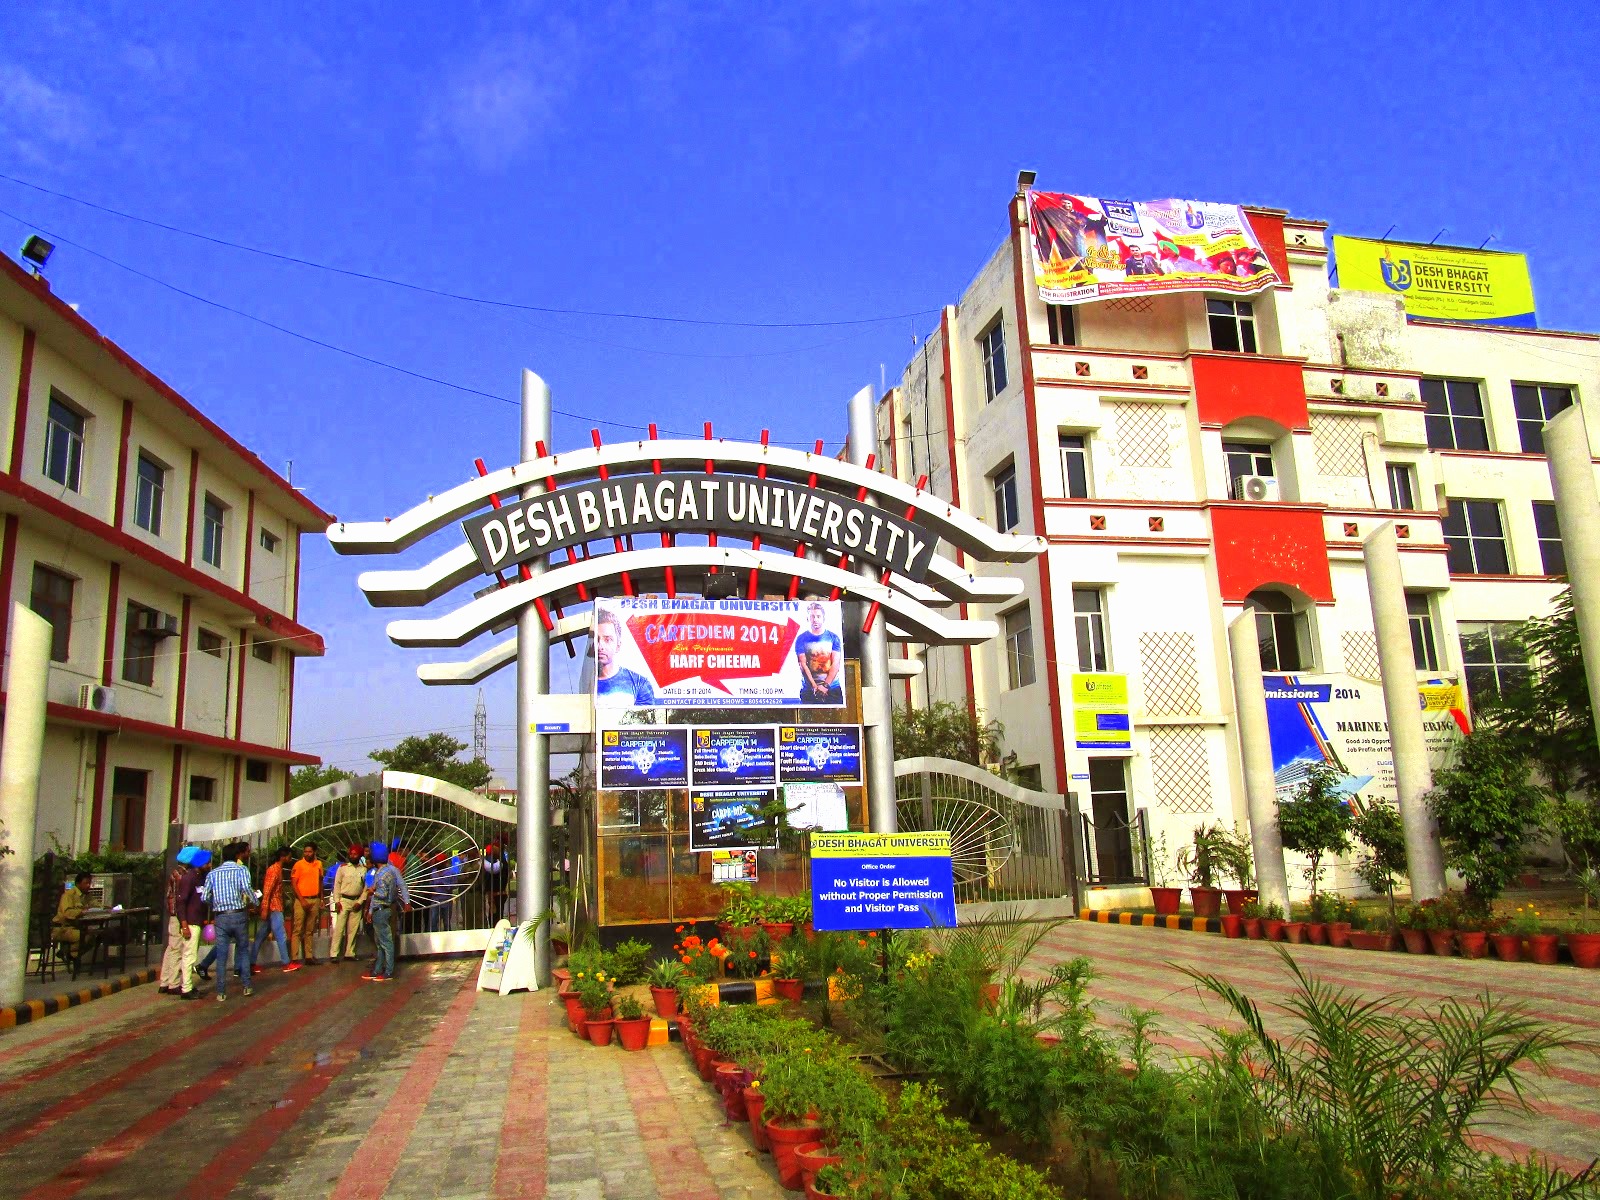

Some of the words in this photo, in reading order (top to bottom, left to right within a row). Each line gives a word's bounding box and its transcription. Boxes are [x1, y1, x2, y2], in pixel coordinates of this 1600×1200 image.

[1084, 257, 1126, 271] November
[1415, 265, 1443, 277] DESH
[1447, 268, 1488, 281] BHAGAT
[1416, 278, 1490, 293] UNIVERSITY
[1053, 288, 1095, 298] REGISTRATION
[482, 494, 577, 566] DESH
[578, 480, 720, 534] BHAGAT
[727, 481, 926, 573] UNIVERSITY
[621, 599, 657, 609] DESH
[662, 599, 716, 610] BHAGAT
[720, 600, 799, 611] UNIVERSITY
[645, 623, 735, 643] CARTEDIEM
[740, 625, 778, 644] 2014
[670, 654, 704, 668] HARF
[707, 654, 761, 669] CHEEMA
[1334, 688, 1360, 699] 2014
[1336, 721, 1382, 732] MARINE
[819, 839, 845, 847] DESH
[848, 838, 888, 847] BHAGAT
[891, 838, 950, 847] UNIVERSITY
[834, 879, 846, 887] No
[849, 878, 880, 887] Visitor
[882, 878, 890, 886] is
[892, 877, 929, 886] Allowed
[819, 891, 856, 900] without
[859, 891, 890, 901] Proper
[892, 890, 943, 899] Permission
[845, 904, 862, 913] and
[865, 904, 895, 912] Visitor
[898, 903, 919, 912] Pass
